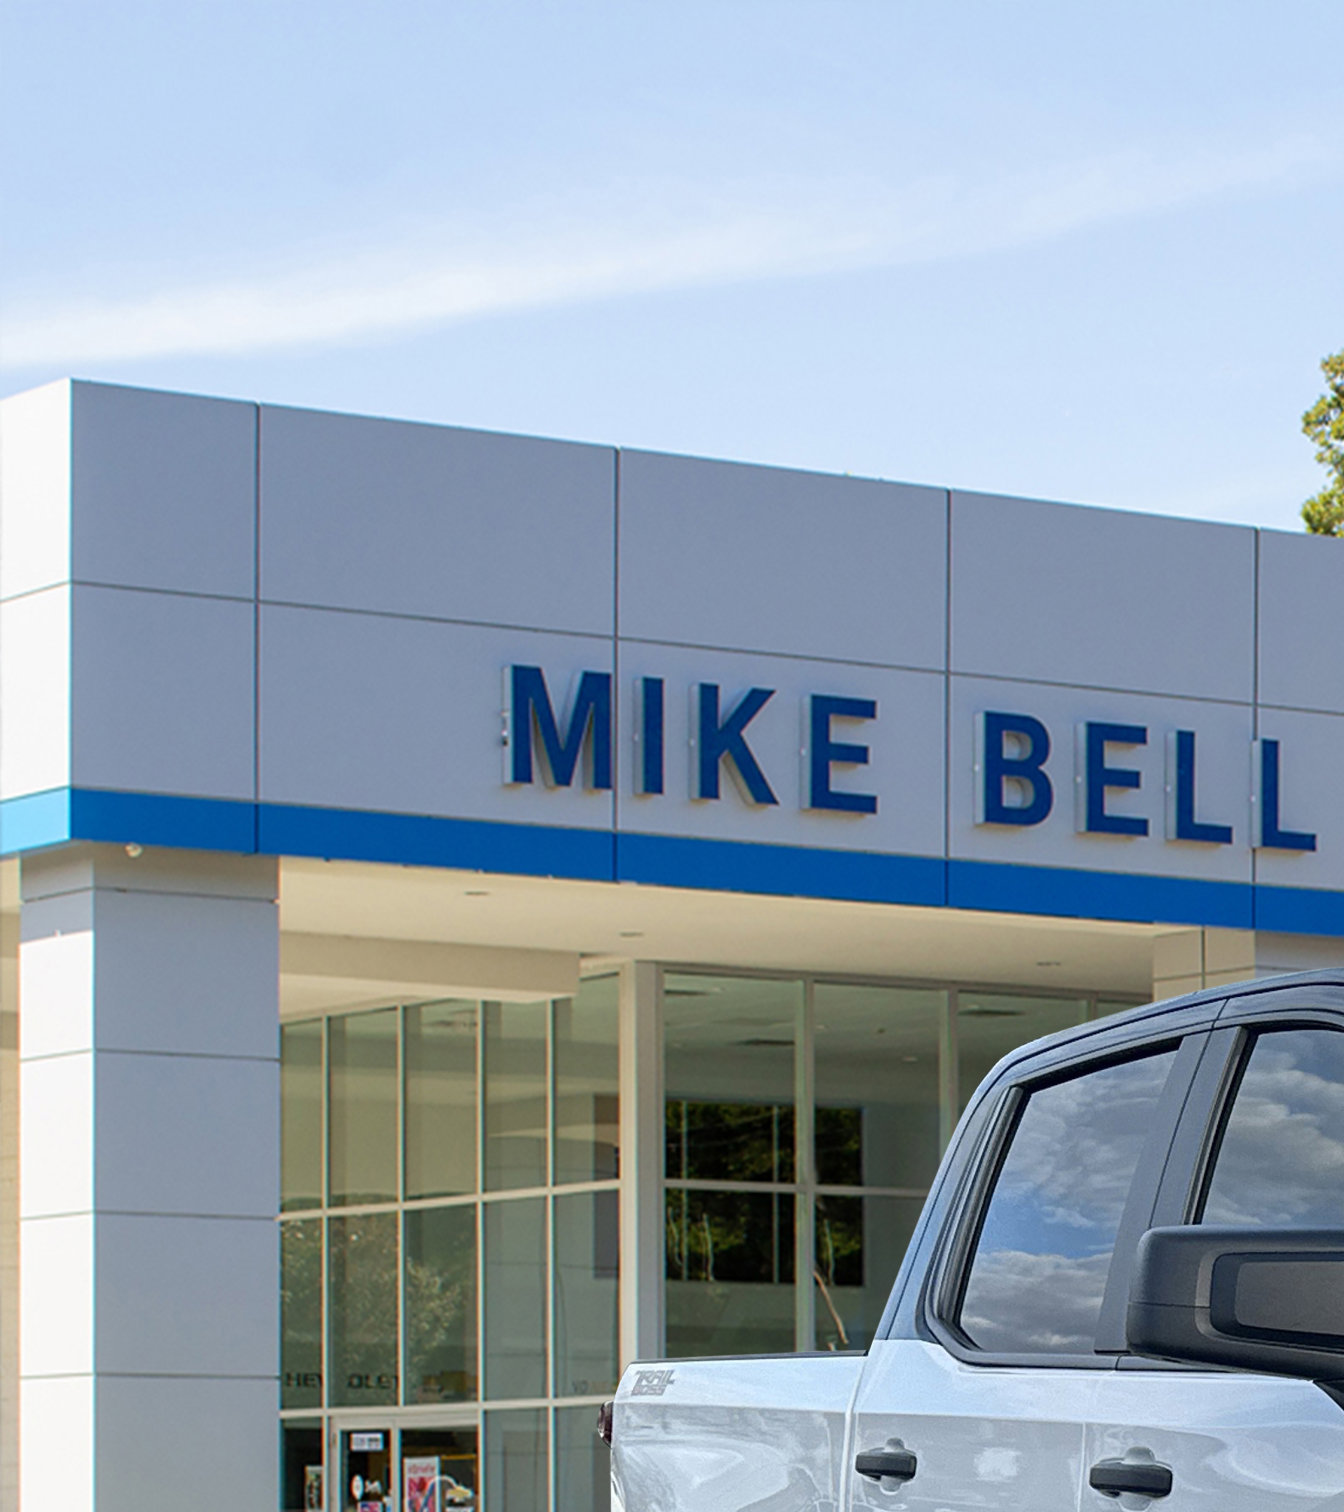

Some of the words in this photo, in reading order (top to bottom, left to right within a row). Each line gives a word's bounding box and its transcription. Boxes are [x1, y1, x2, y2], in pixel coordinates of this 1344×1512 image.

[505, 664, 878, 814] MIKE
[976, 711, 1317, 852] BELL
[635, 1370, 675, 1385] TRAIL
